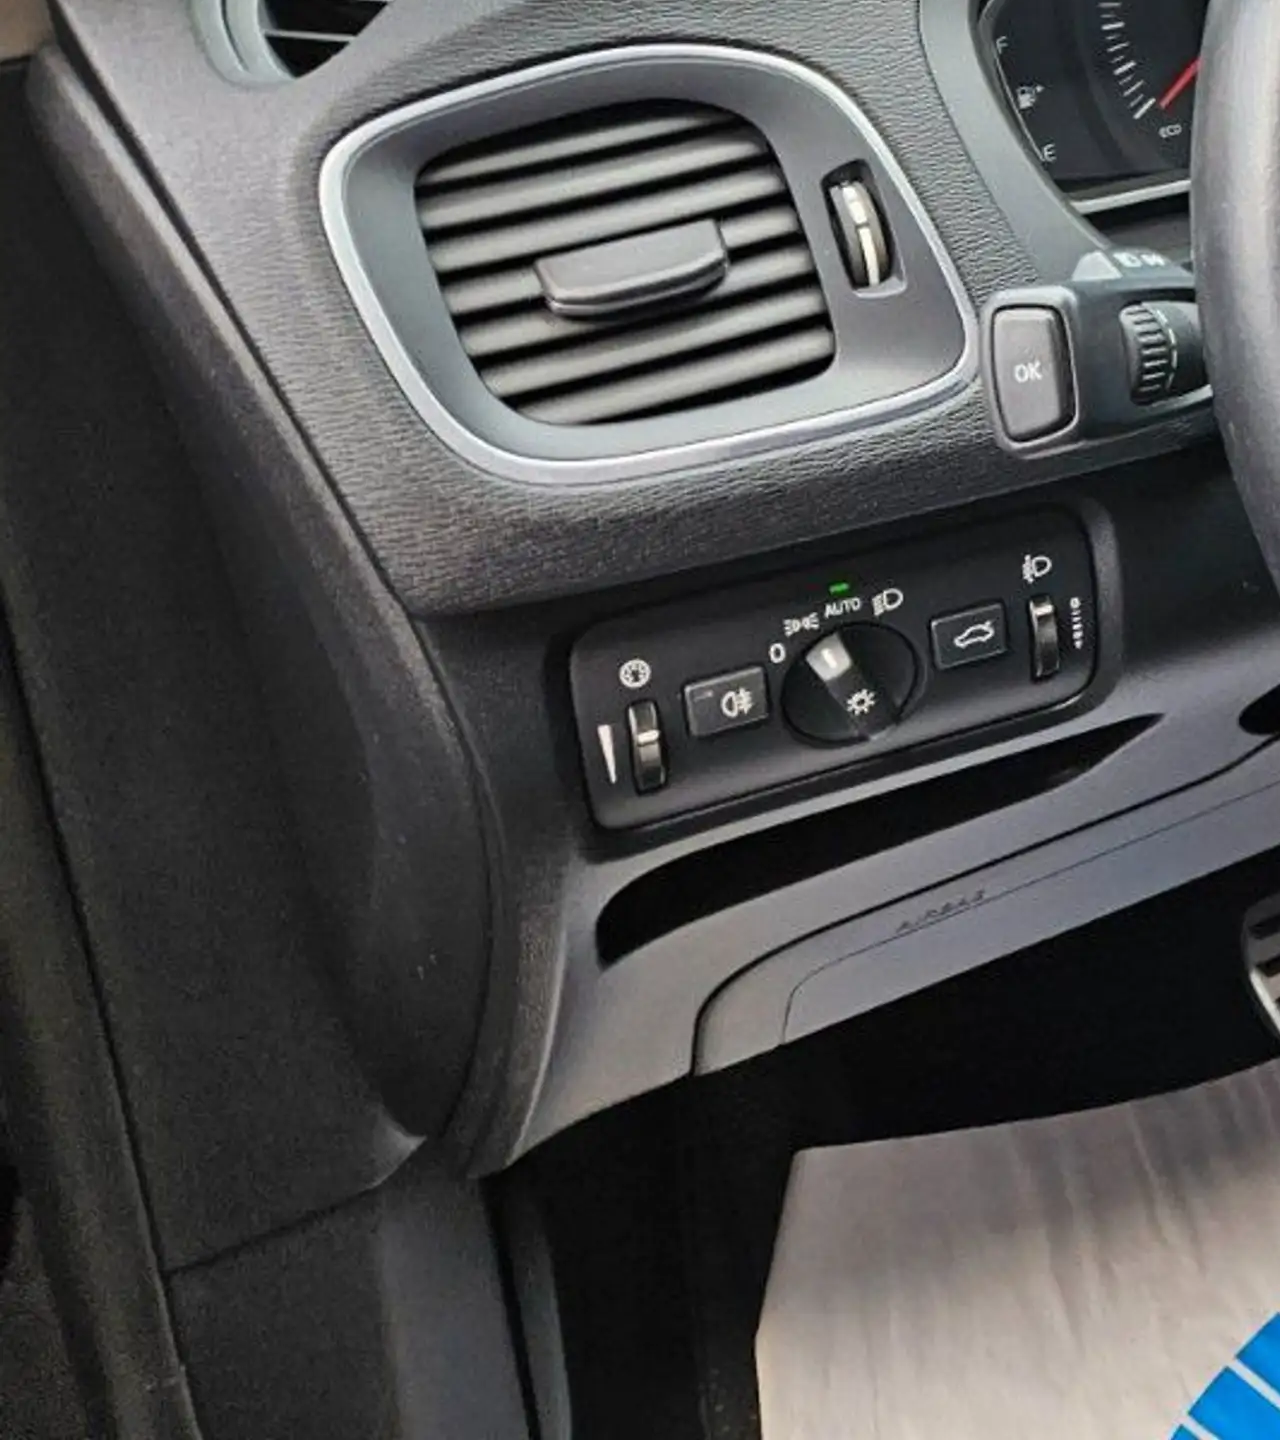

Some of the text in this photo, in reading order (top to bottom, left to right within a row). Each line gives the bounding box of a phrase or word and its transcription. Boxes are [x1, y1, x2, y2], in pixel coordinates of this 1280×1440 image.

[996, 36, 1008, 54] F
[1043, 143, 1056, 162] E
[1014, 359, 1043, 383] OK
[824, 597, 860, 619] AUTO
[769, 643, 786, 664] 0
